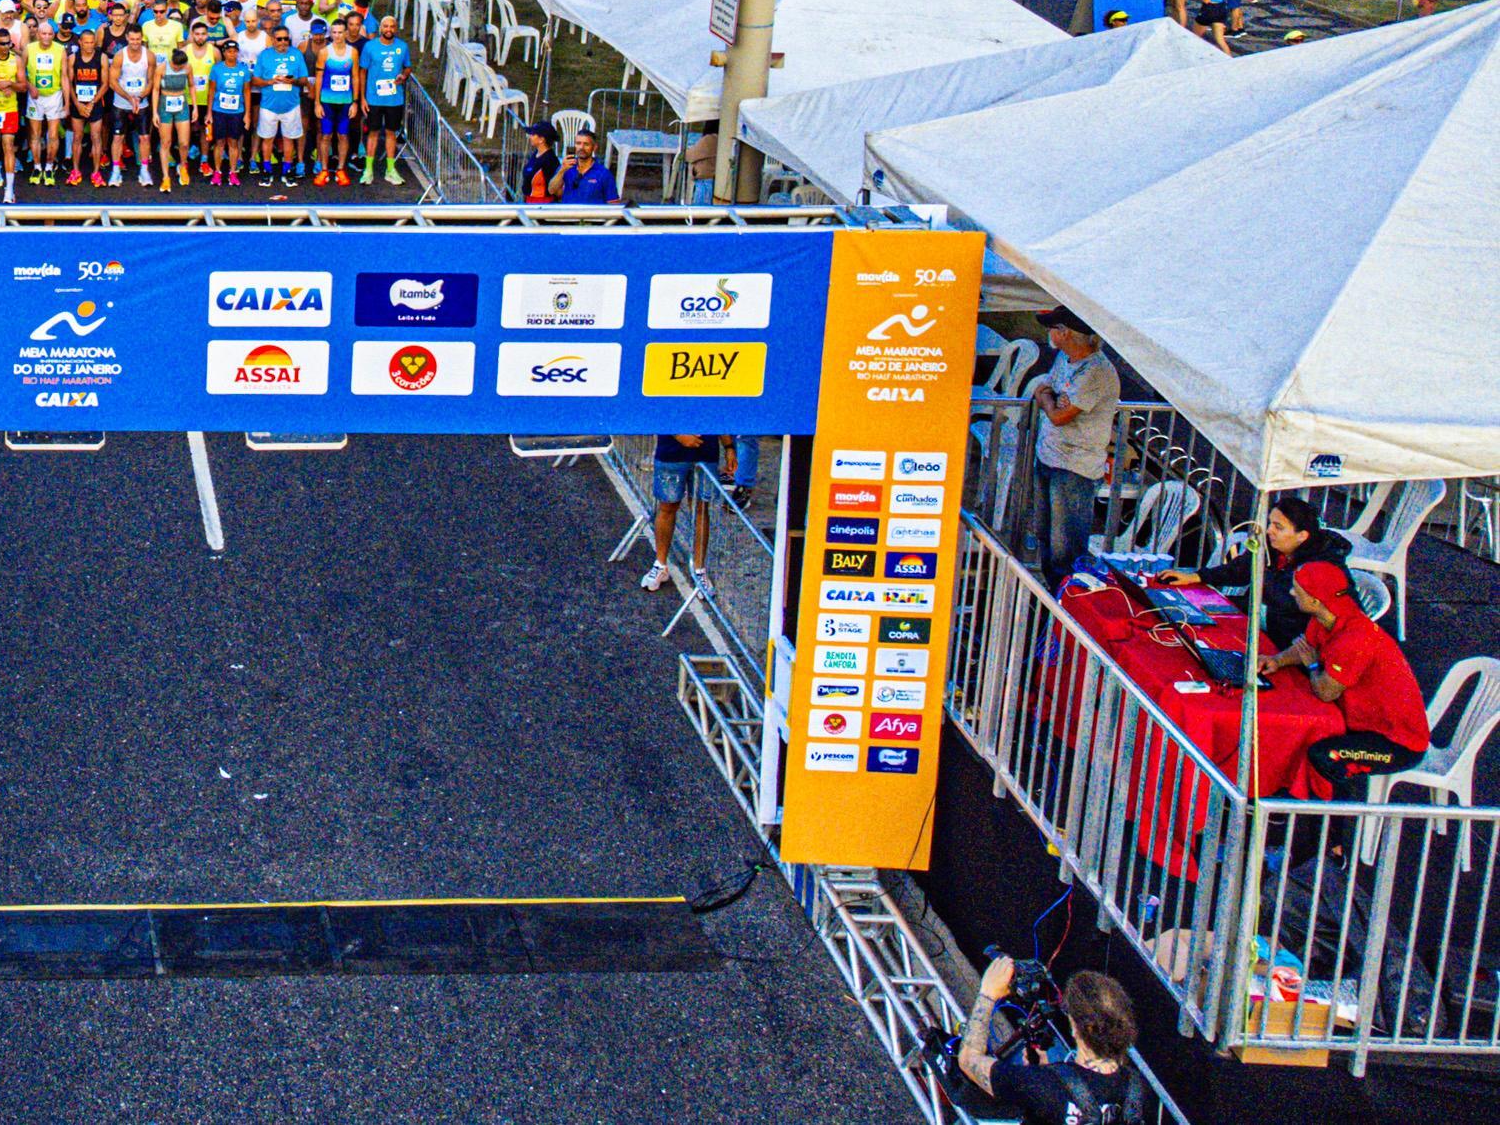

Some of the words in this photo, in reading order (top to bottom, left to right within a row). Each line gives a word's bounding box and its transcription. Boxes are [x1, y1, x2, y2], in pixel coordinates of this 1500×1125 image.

[13, 263, 62, 278] movida
[77, 261, 103, 281] 50
[913, 269, 937, 287] 50
[216, 287, 324, 311] CAIXA
[680, 296, 722, 312] G20
[526, 318, 543, 326] RIO
[544, 318, 556, 326] DE
[558, 318, 596, 326] JANEIRO
[19, 347, 48, 358] MEIA
[49, 347, 117, 358] MARATONA
[855, 345, 882, 356] MEIA
[883, 346, 944, 357] MARATONA
[13, 363, 33, 375] DO
[34, 363, 55, 375] RIO
[56, 363, 72, 375] DE
[73, 363, 123, 375] JANEIRO
[670, 350, 740, 380] BALY
[848, 360, 867, 371] DO
[868, 360, 887, 371] RIO
[888, 361, 903, 372] DE
[904, 362, 948, 373] JANEIRO
[531, 364, 588, 383] Sesc
[22, 376, 38, 385] RIO
[39, 376, 60, 385] HALF
[62, 376, 112, 385] MARATHON
[35, 391, 99, 407] CAIXA
[866, 386, 925, 402] CAIXA
[914, 461, 941, 472] leão
[835, 490, 876, 503] movida
[895, 494, 938, 504] Cunhados
[829, 523, 876, 537] cinépolis
[831, 552, 868, 570] BALY
[826, 589, 876, 602] CAIXA
[888, 631, 920, 640] COPRA
[825, 651, 857, 660] BENDITA
[874, 717, 918, 736] Afya
[822, 752, 854, 761] yescom
[1338, 749, 1392, 764] ChipTiming
